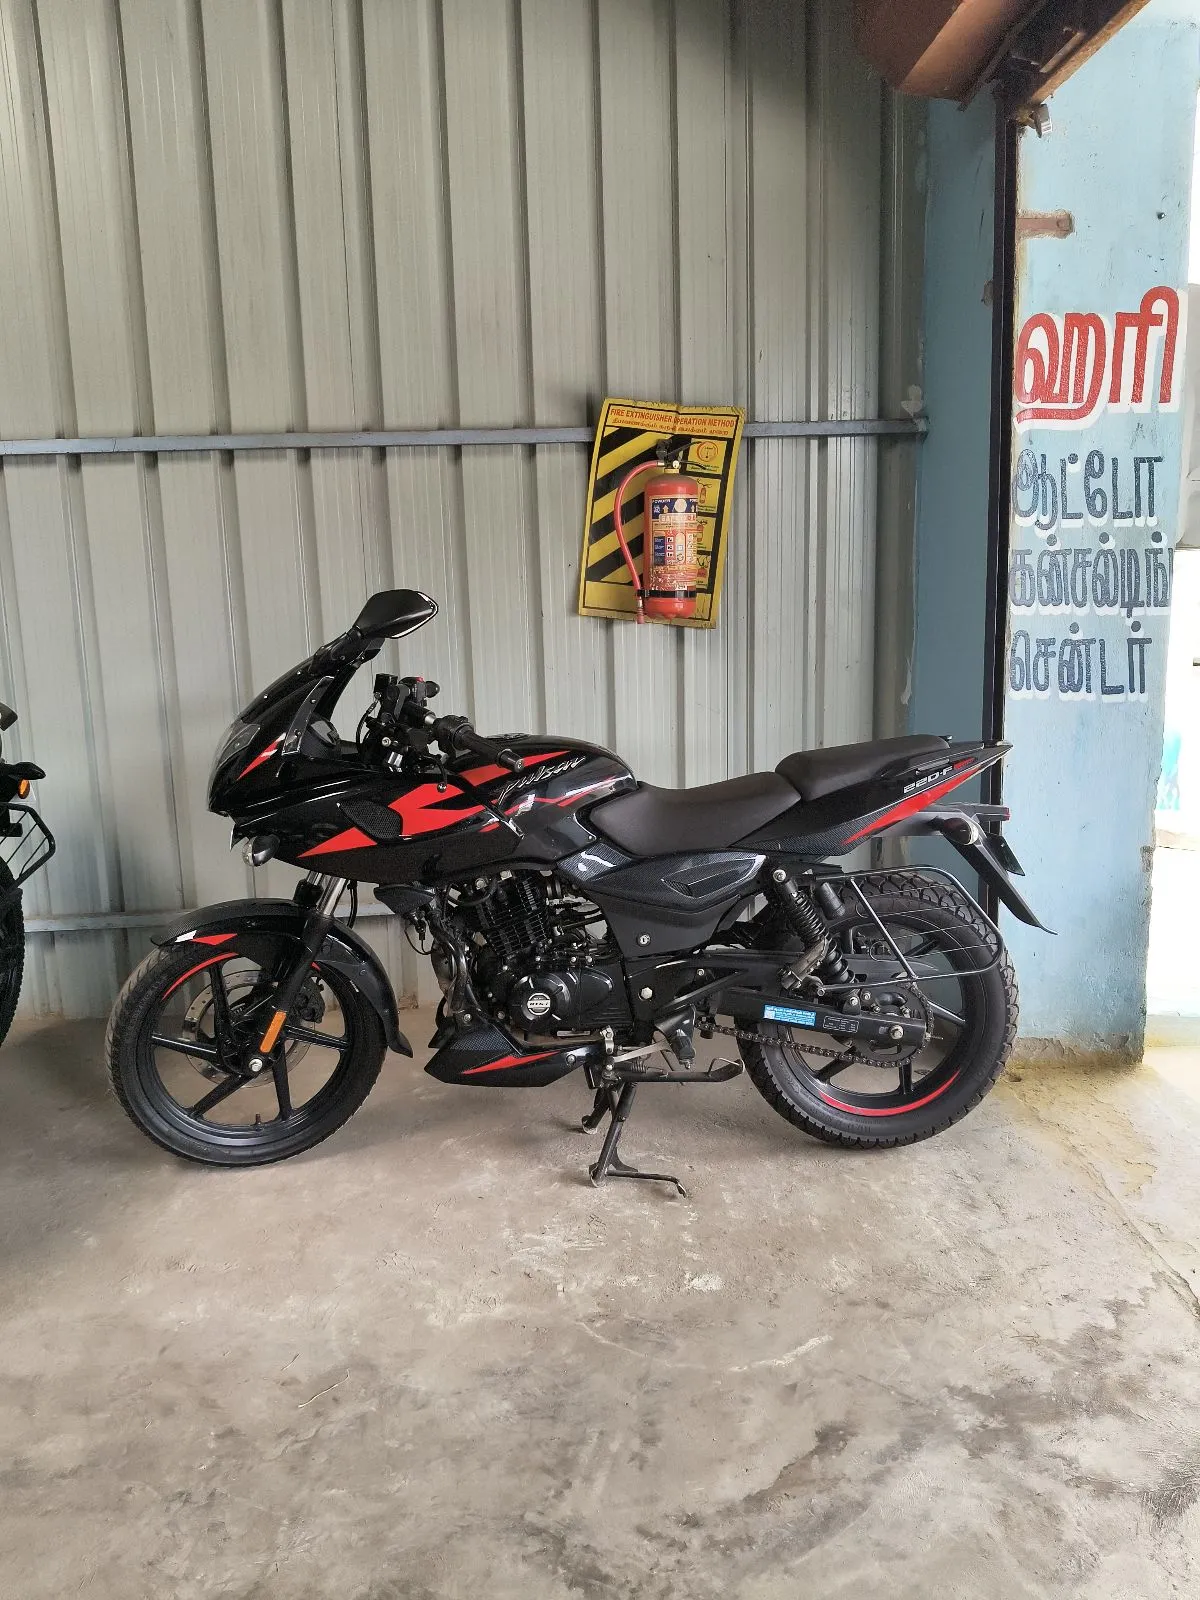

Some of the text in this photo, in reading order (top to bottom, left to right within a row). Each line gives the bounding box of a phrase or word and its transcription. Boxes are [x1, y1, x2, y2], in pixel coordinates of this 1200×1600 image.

[1014, 285, 1180, 425] ஹரி
[610, 408, 735, 428] FIRE EXTINGUISHER OPERATION METHOD
[1012, 449, 1164, 531] ஆட்டோ
[1009, 620, 1153, 695] சென்டர்
